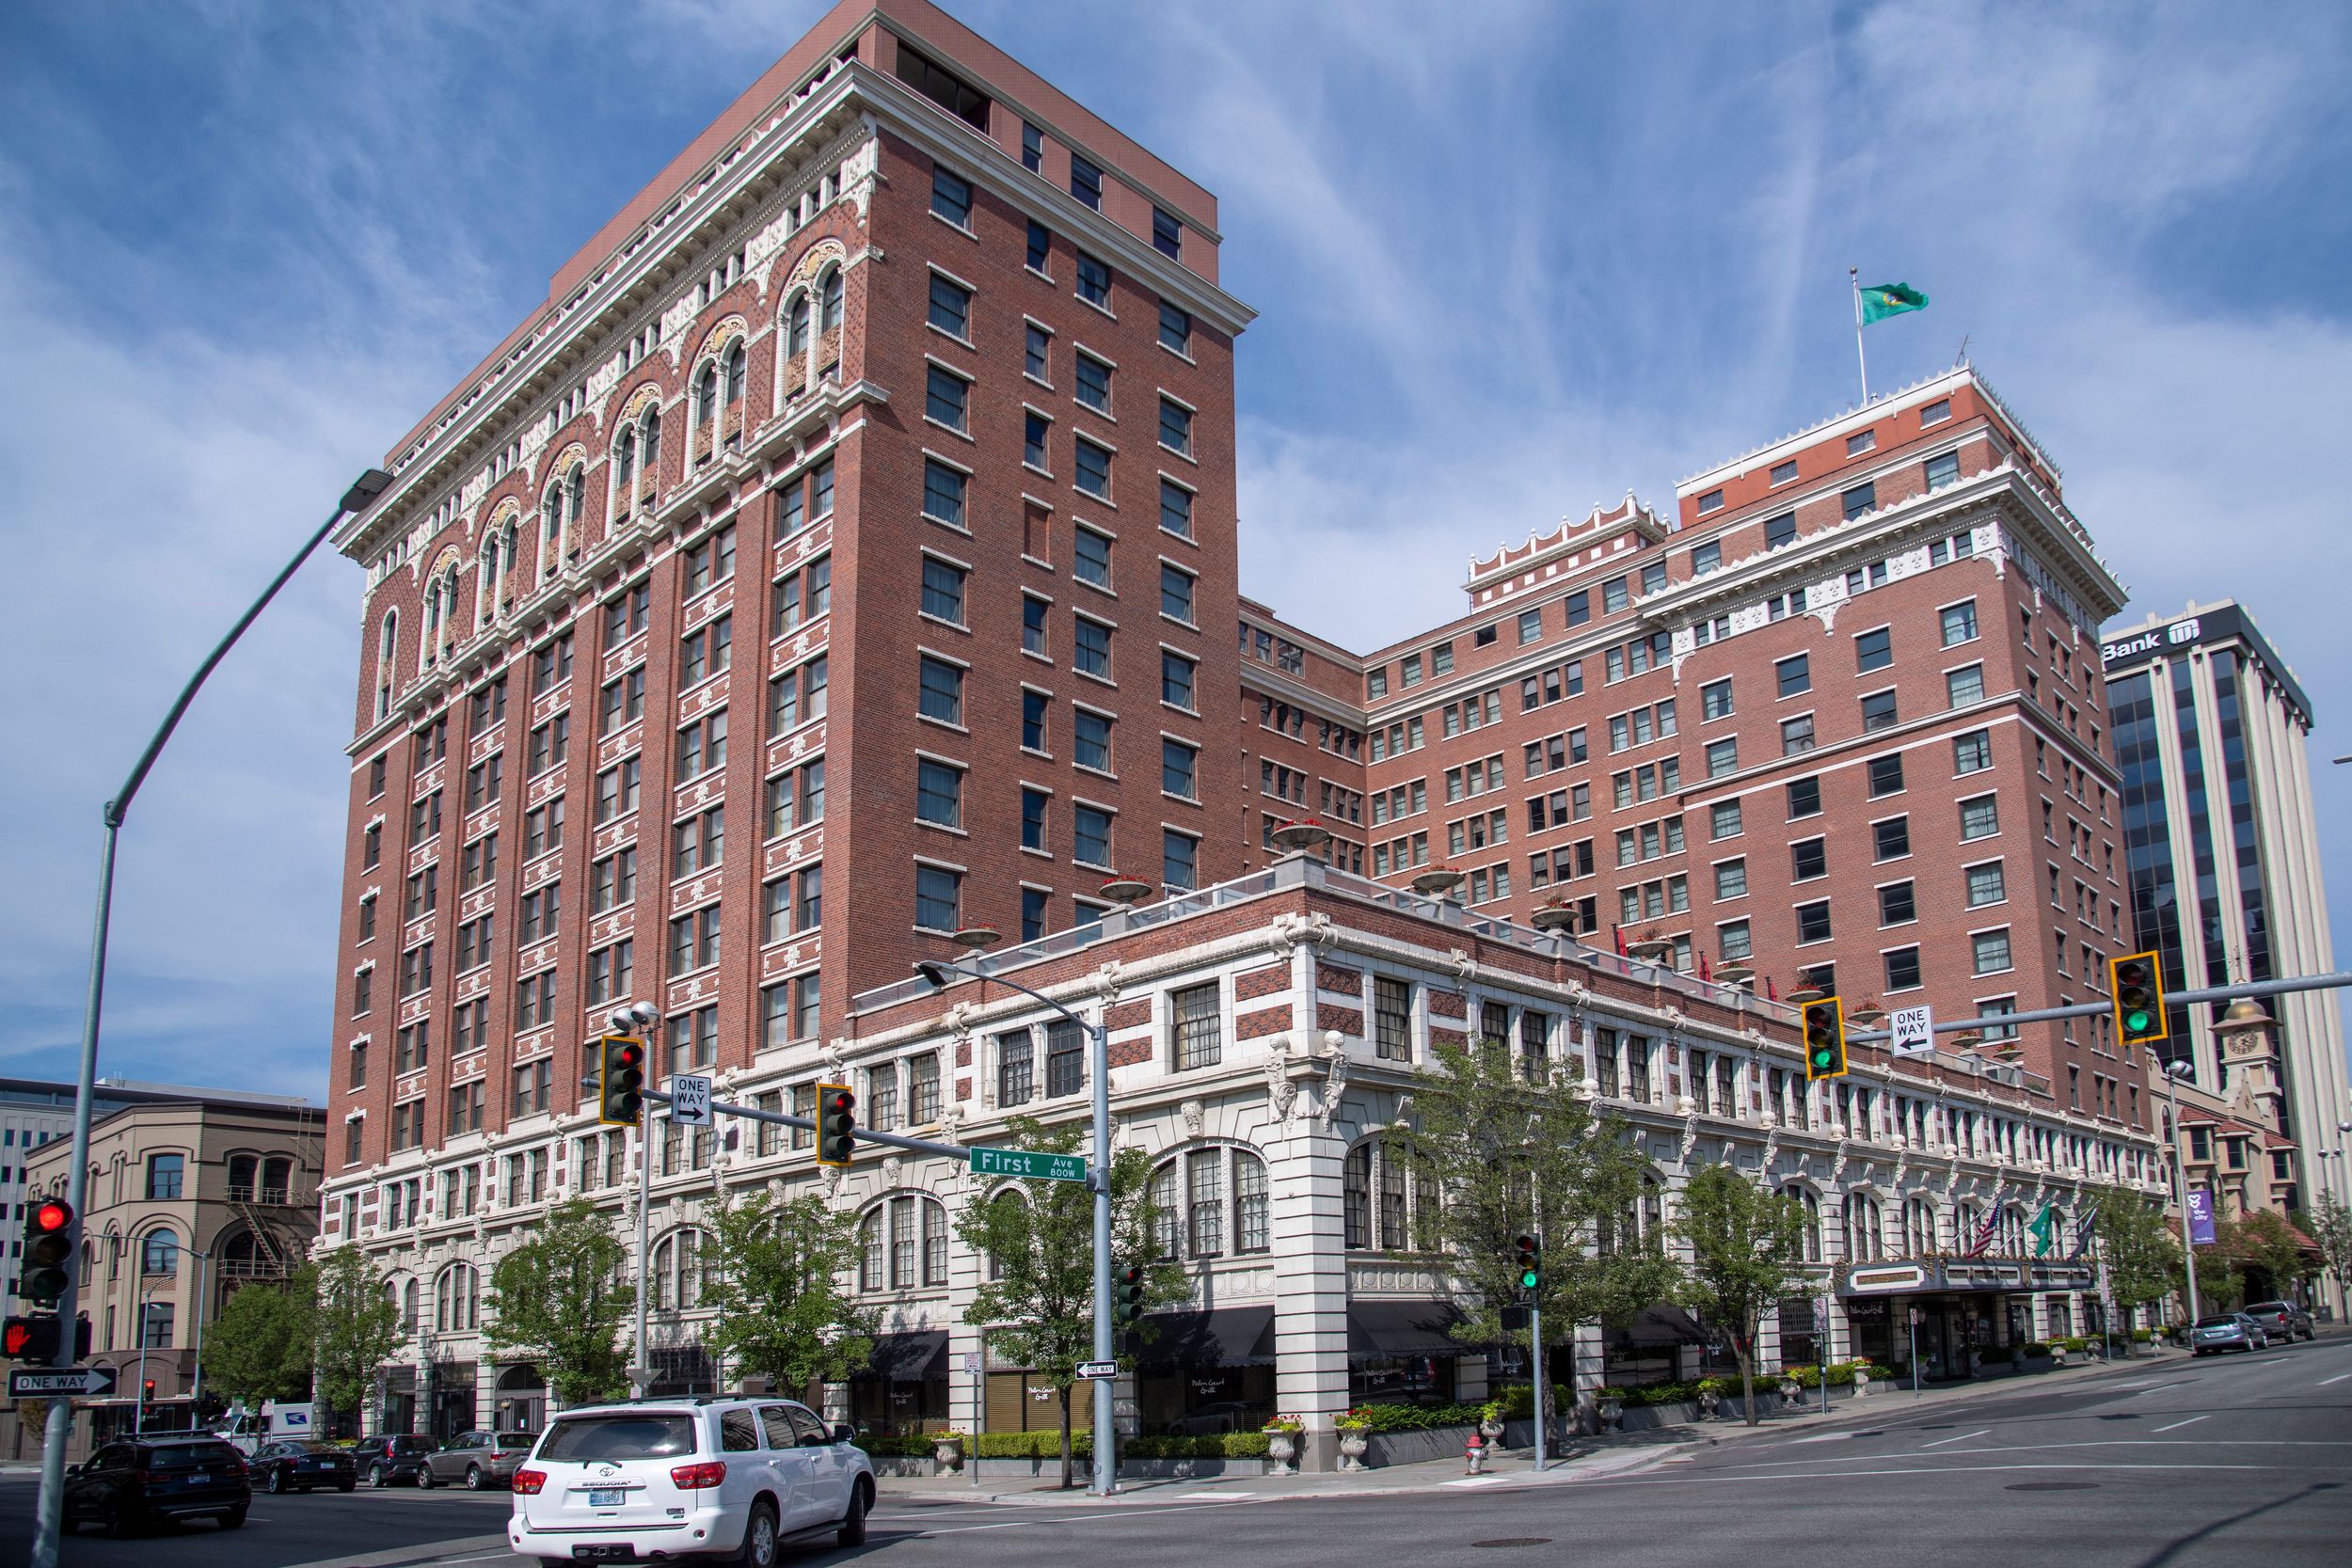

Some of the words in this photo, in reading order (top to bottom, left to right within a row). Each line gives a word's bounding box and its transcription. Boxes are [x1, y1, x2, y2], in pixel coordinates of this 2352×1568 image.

[2102, 633, 2161, 661] Bank
[1898, 1009, 1925, 1024] ONE
[1897, 1022, 1926, 1037] WAY
[678, 1079, 705, 1092] ONE
[677, 1092, 706, 1105] WAY
[982, 1152, 1031, 1173] First
[1053, 1157, 1073, 1168] Ave
[1050, 1168, 1075, 1178] 800W
[20, 1377, 52, 1389] ONE
[54, 1376, 88, 1387] WAY
